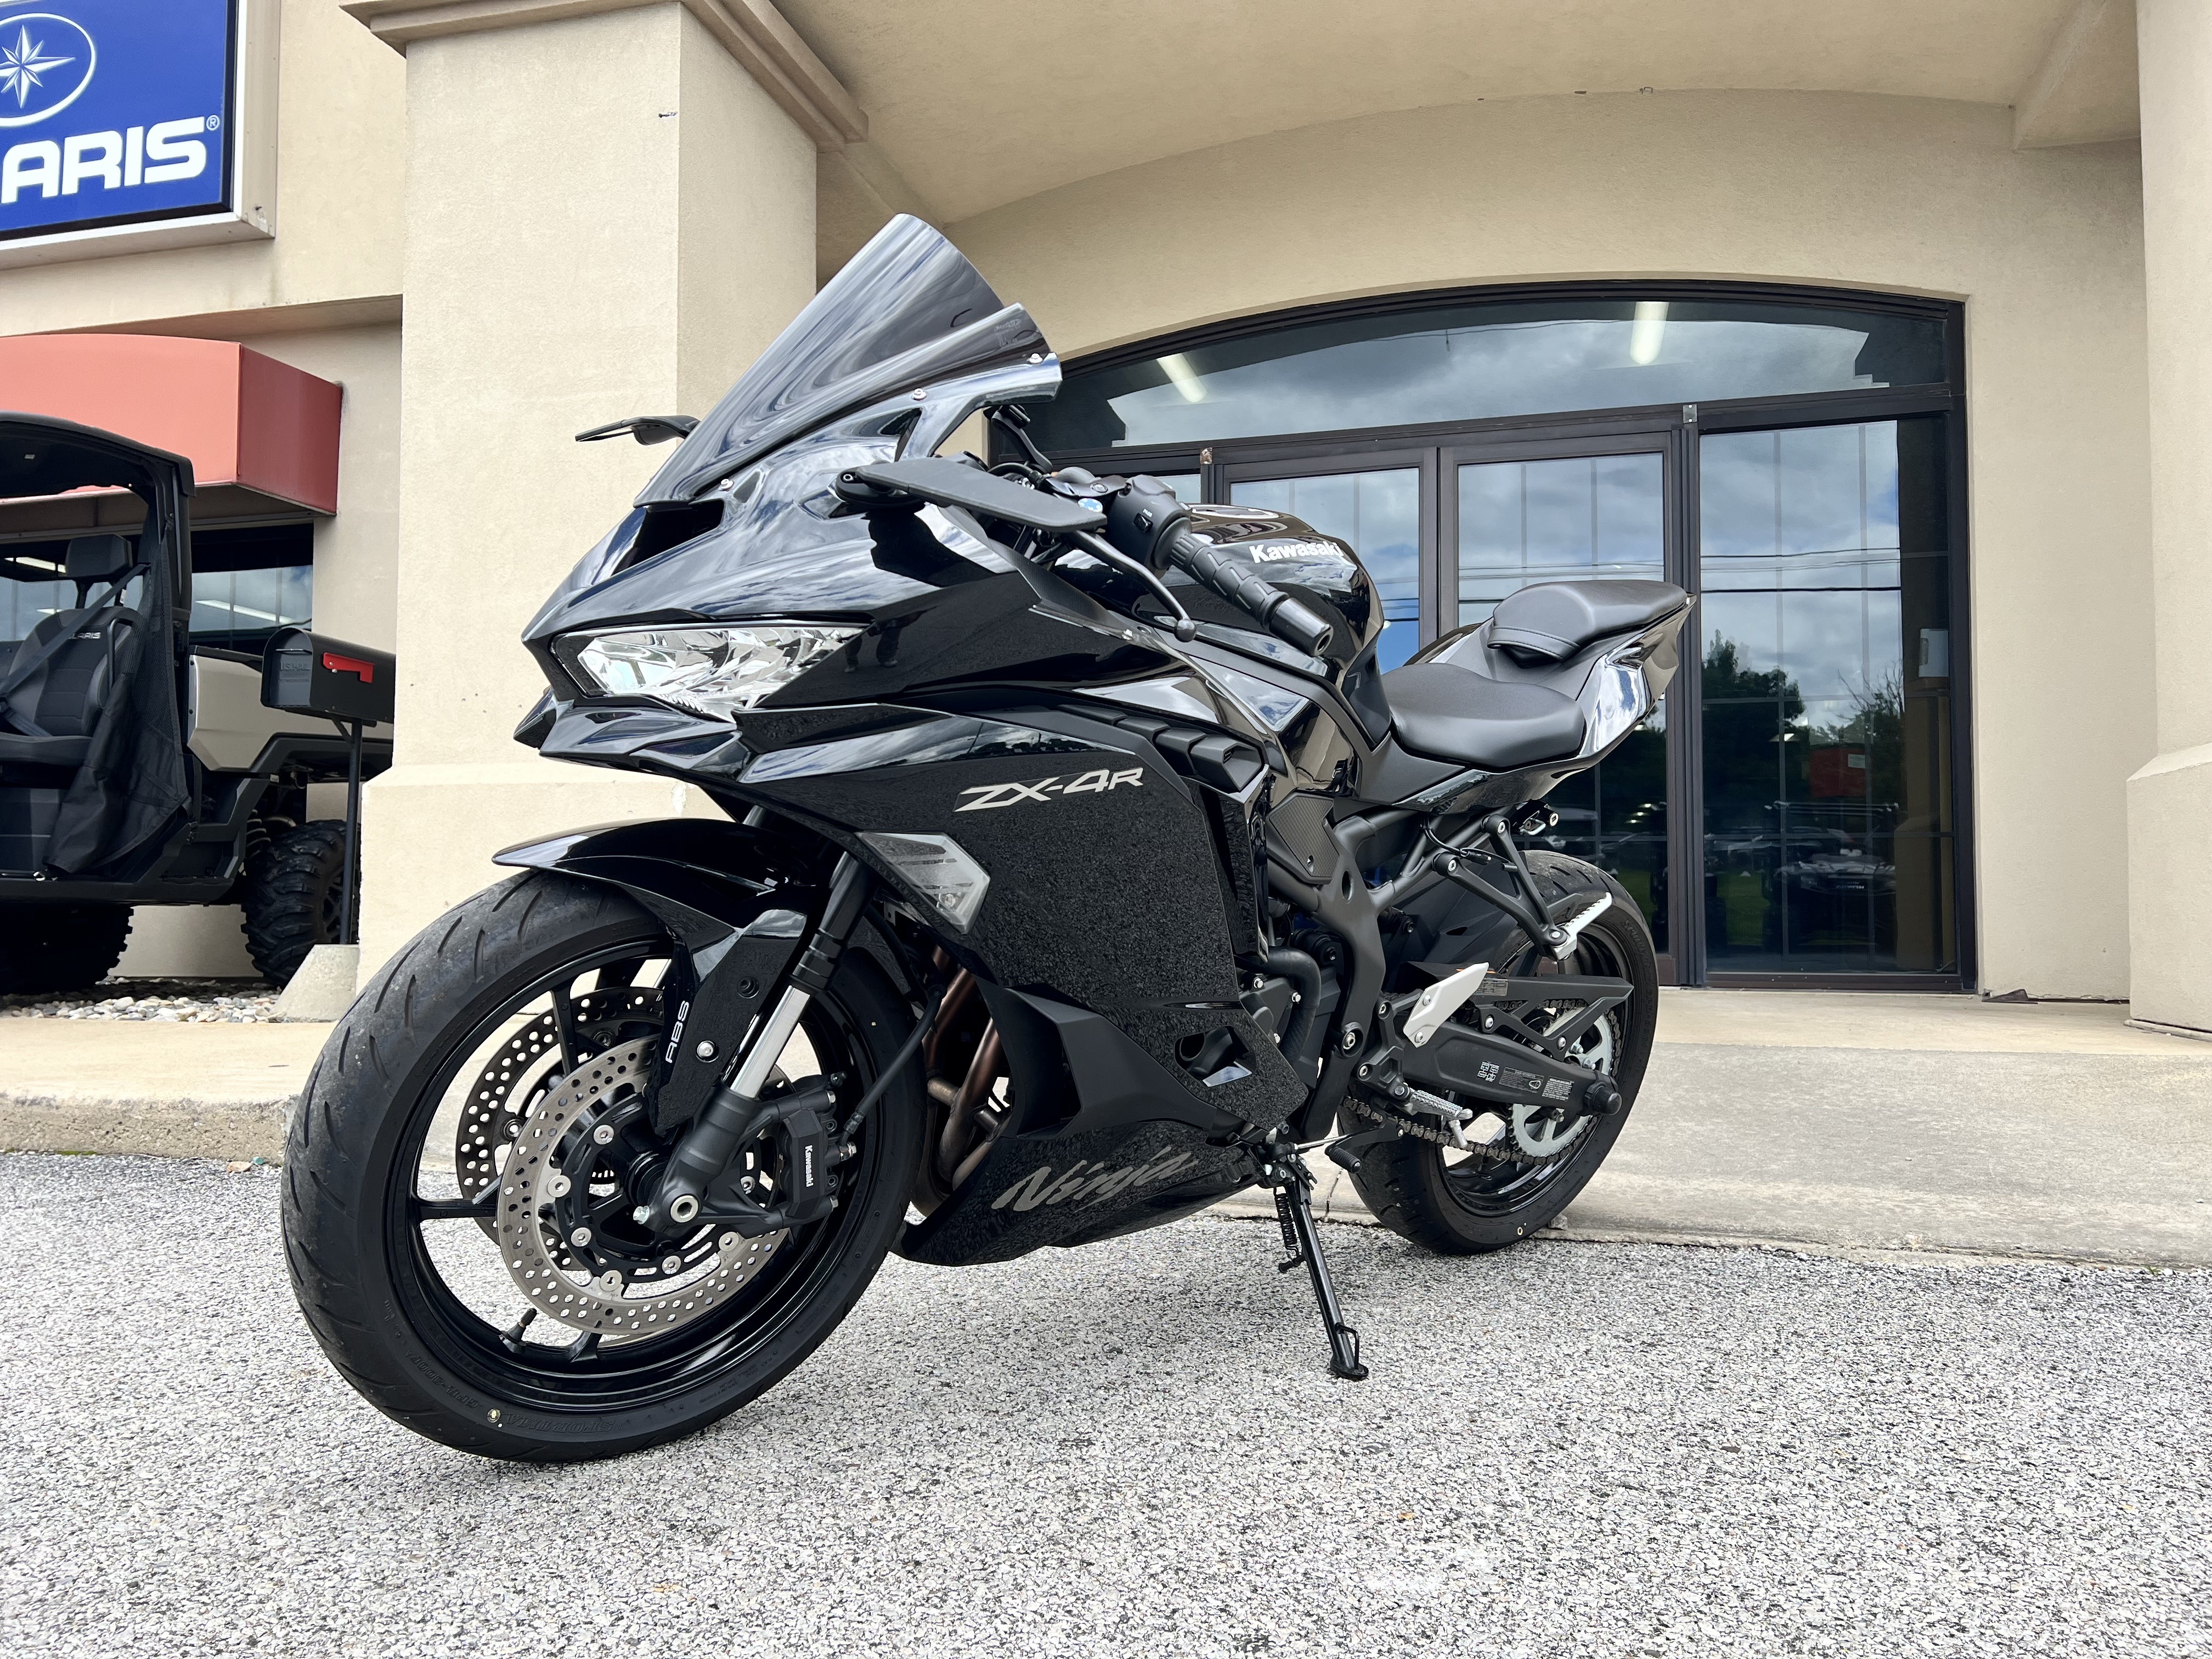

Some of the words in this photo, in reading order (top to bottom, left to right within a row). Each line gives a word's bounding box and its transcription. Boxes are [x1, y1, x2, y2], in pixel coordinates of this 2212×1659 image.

[1249, 541, 1344, 563] Kawasaki
[953, 768, 1143, 812] ZX-4R
[665, 1000, 690, 1063] ABS
[805, 1145, 814, 1188] Kawasaki
[991, 1146, 1199, 1213] Ninja
[501, 1410, 616, 1434] SPORTMA
